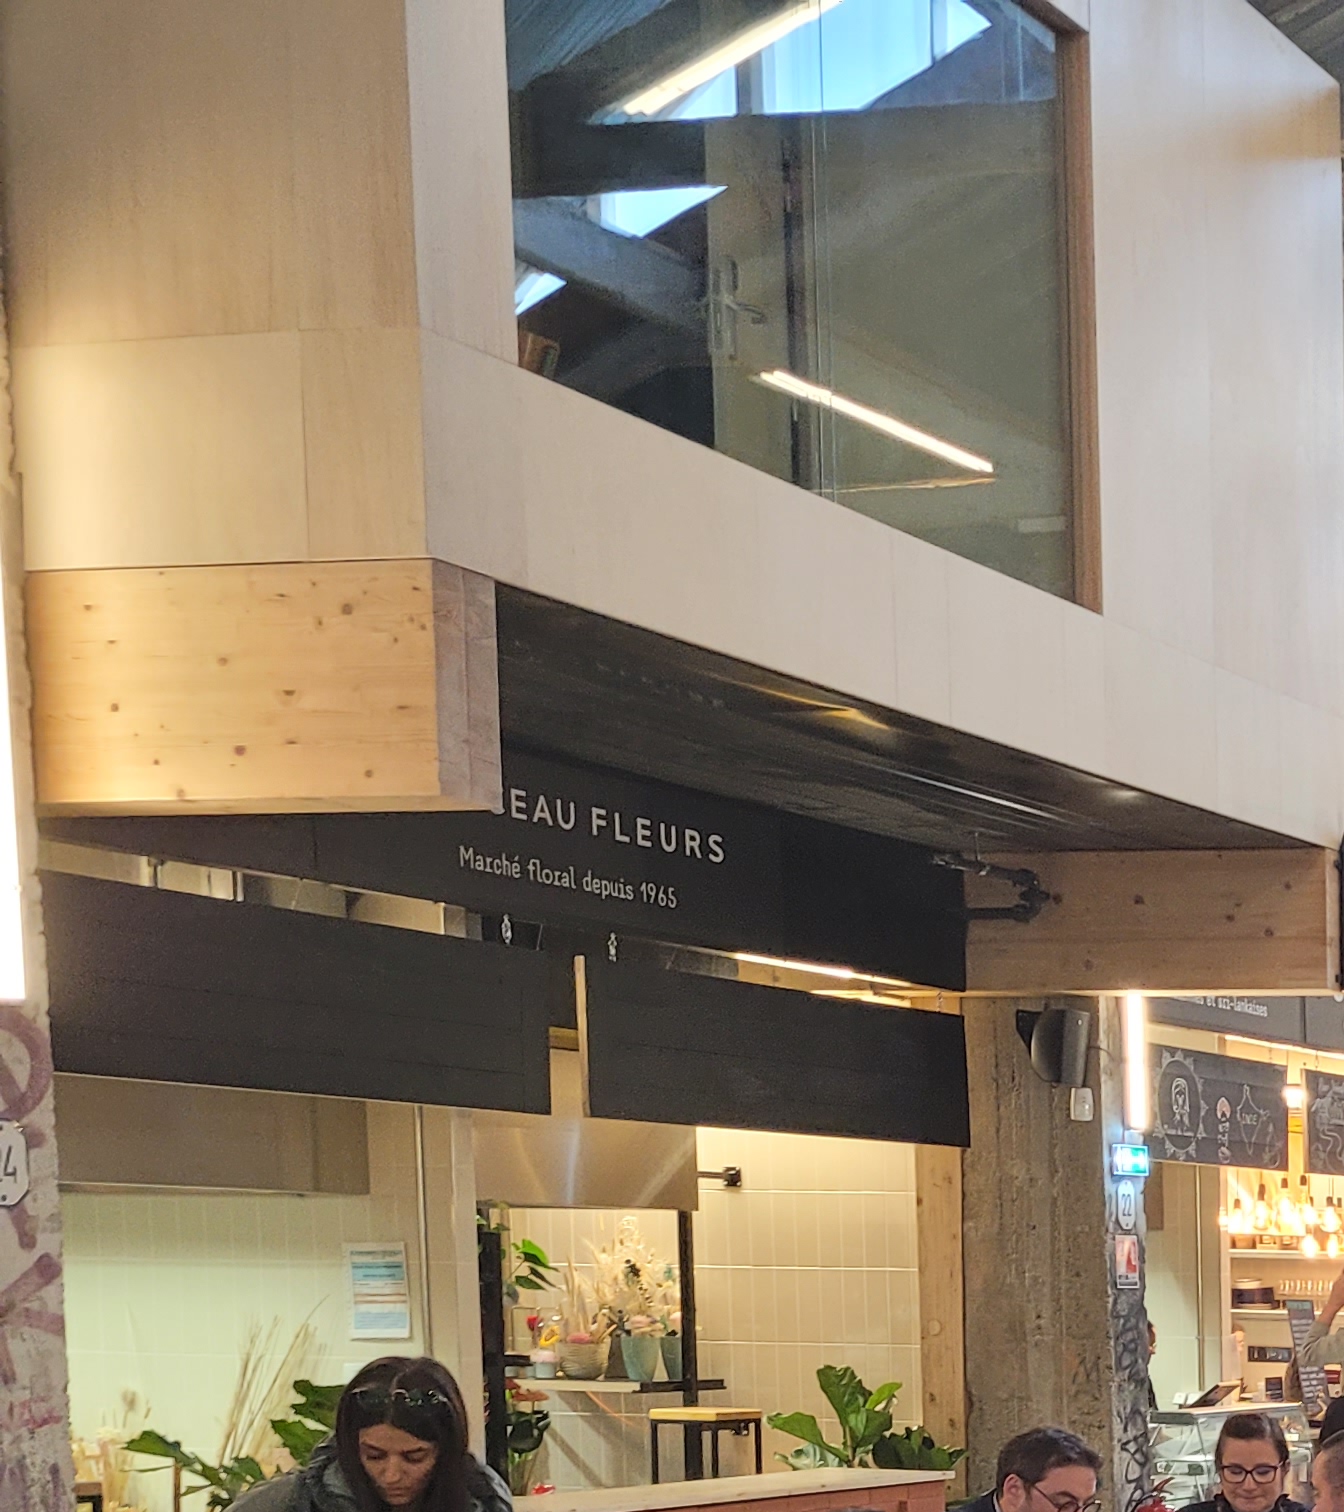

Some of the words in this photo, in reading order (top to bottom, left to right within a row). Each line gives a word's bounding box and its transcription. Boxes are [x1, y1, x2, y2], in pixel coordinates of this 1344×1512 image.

[499, 787, 576, 830] EAU
[591, 806, 725, 864] FLEURS
[459, 845, 521, 879] Marché
[527, 858, 577, 890] floral
[582, 870, 634, 900] depuis
[639, 880, 677, 909] 1965
